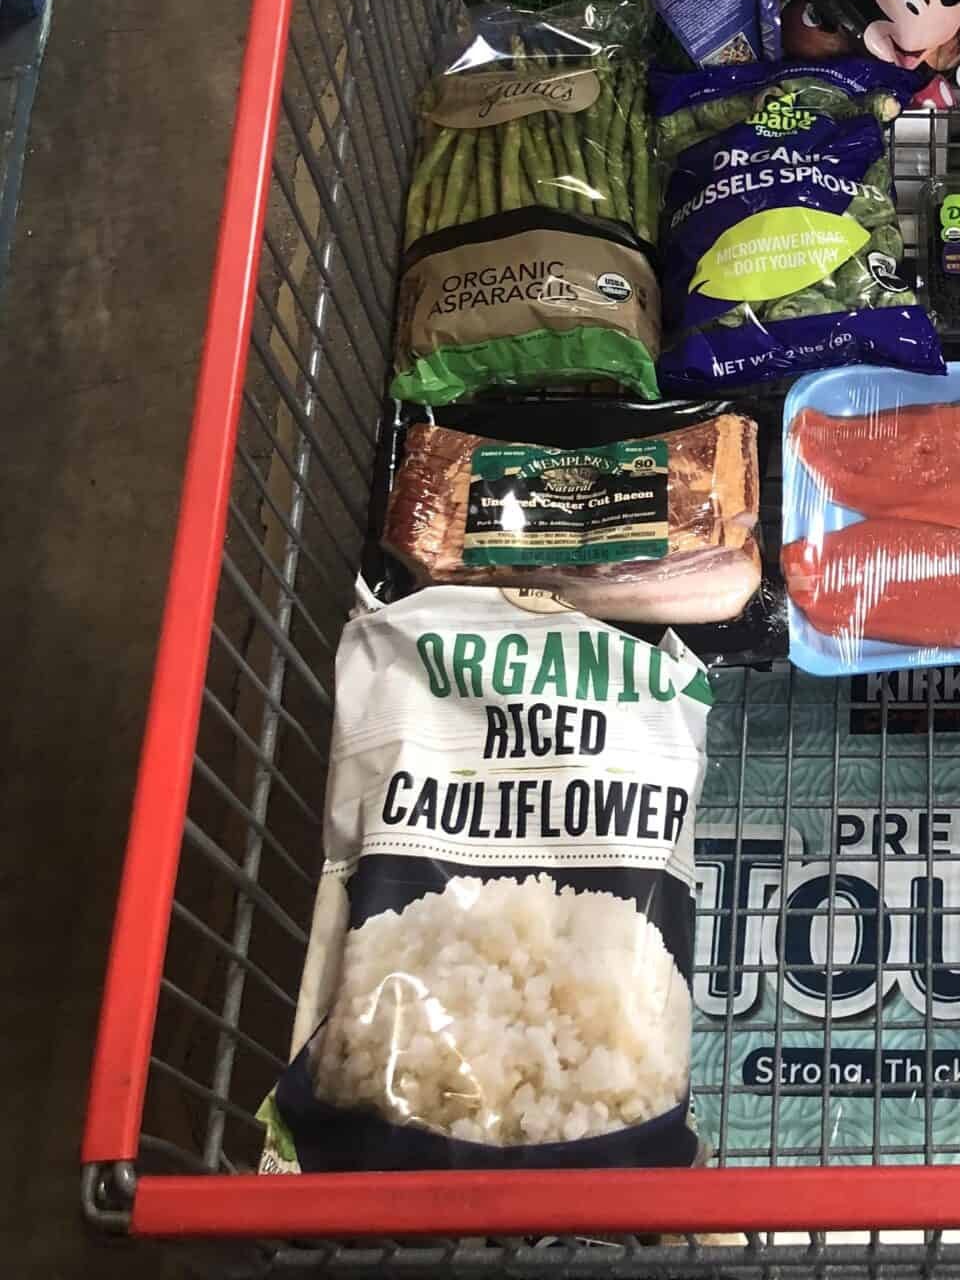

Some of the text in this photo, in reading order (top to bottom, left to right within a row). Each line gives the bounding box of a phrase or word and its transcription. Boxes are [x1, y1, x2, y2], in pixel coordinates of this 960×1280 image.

[671, 166, 887, 229] BRUSSELS SPROUTS
[716, 233, 799, 265] MICROWAVE
[769, 251, 807, 270] YOUR
[441, 260, 565, 293] ORGANIC
[429, 277, 579, 317] ASPARAGUS
[711, 357, 746, 378] NET
[634, 458, 654, 469] 80
[543, 481, 594, 494] Natural
[588, 496, 611, 509] Cut
[614, 489, 655, 504] Bacon
[416, 631, 679, 703] ORGANIC
[483, 703, 607, 760] RICED
[381, 771, 690, 843] CAULIFLOWER
[755, 1056, 873, 1086] Strong,
